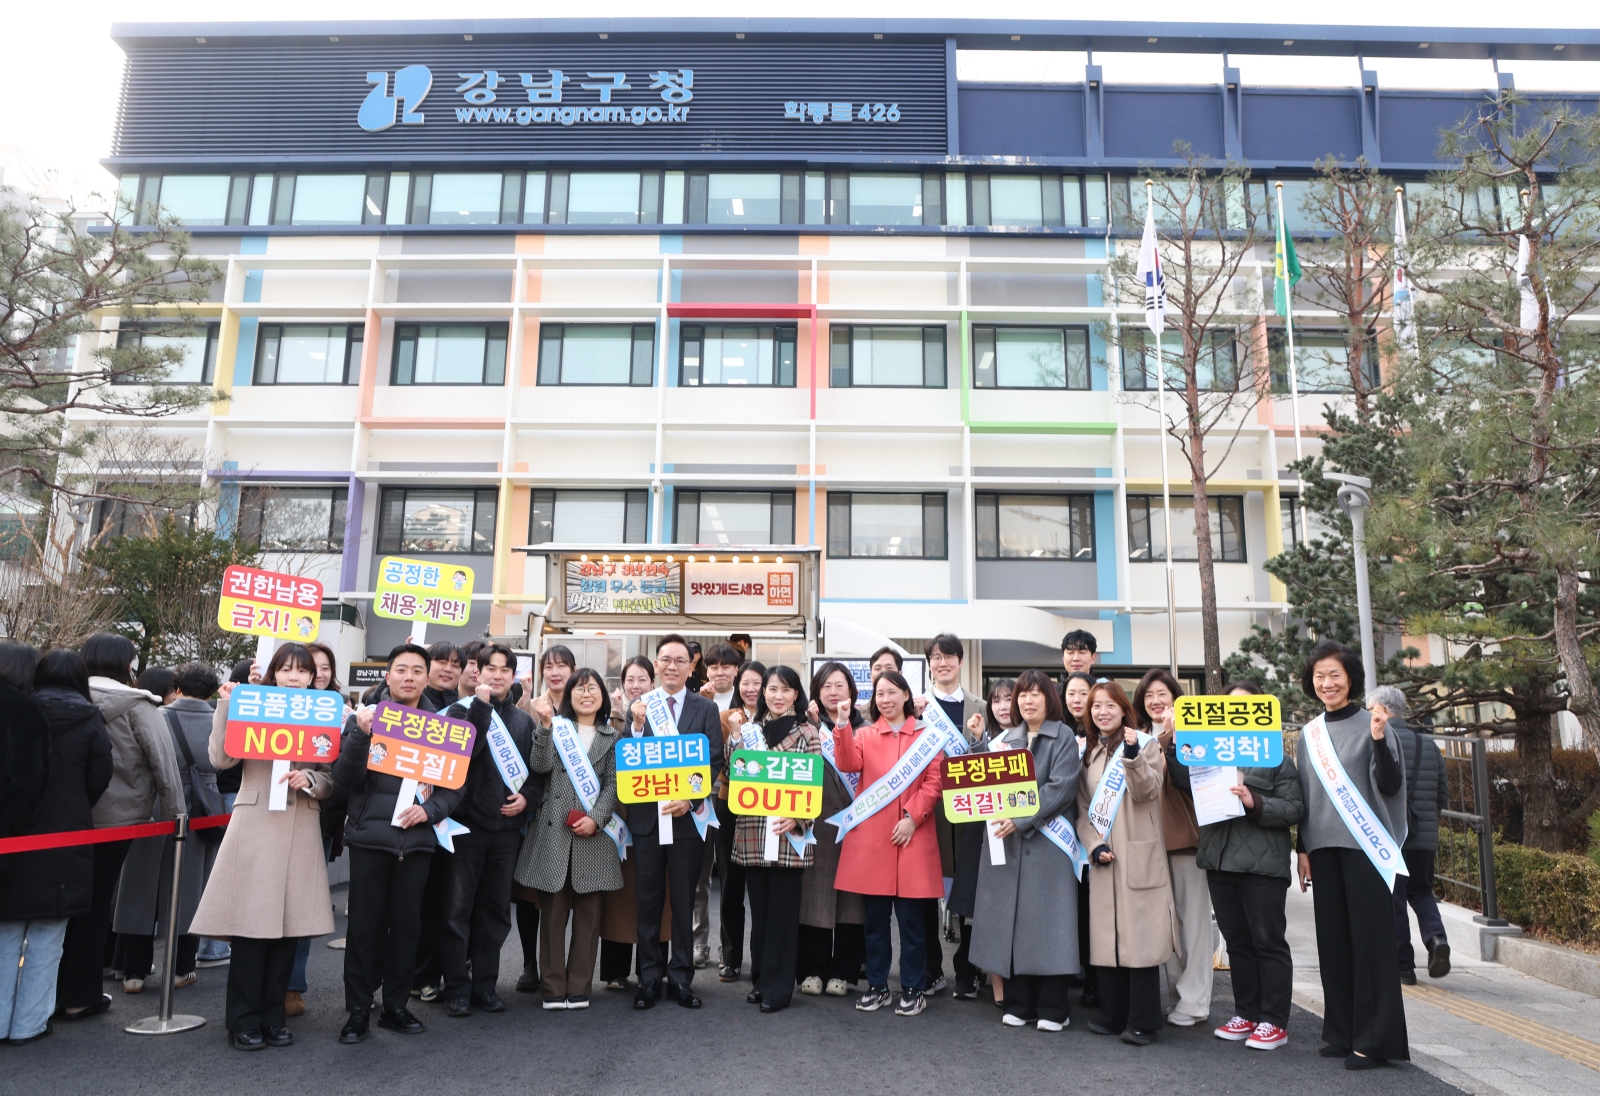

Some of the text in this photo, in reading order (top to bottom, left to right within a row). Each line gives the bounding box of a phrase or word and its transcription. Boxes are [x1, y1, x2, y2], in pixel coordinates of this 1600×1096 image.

[455, 69, 694, 105] 강남구청
[455, 103, 690, 126] www.gangnam.go.kr
[784, 101, 901, 125] 학동로 426
[384, 561, 440, 588] 공정한
[580, 563, 616, 576] 강남구
[229, 571, 319, 607] 권한남용
[580, 579, 667, 593] 청렴 우수 등급
[690, 582, 765, 596] 맛있게드세요
[769, 586, 792, 598] 하면
[380, 592, 466, 621] 채용·계약!
[569, 592, 677, 612] 여러분 덕분입니다
[232, 603, 291, 633] 금지!
[237, 689, 337, 722] 금품향응
[647, 690, 669, 726] 청렴
[1181, 701, 1274, 726] 친절공정
[243, 727, 305, 756] NO!
[378, 706, 472, 751] 부정청탁
[622, 738, 705, 766] 청렴리더
[1213, 735, 1270, 762] 정착!
[395, 745, 457, 782] 근절!
[766, 756, 814, 782] 갑질
[946, 752, 1029, 784] 부정부패
[631, 773, 679, 798] 강남!
[737, 786, 813, 813] OUT!
[952, 791, 1004, 816] 척결!
[1090, 813, 1112, 829] 오케이
